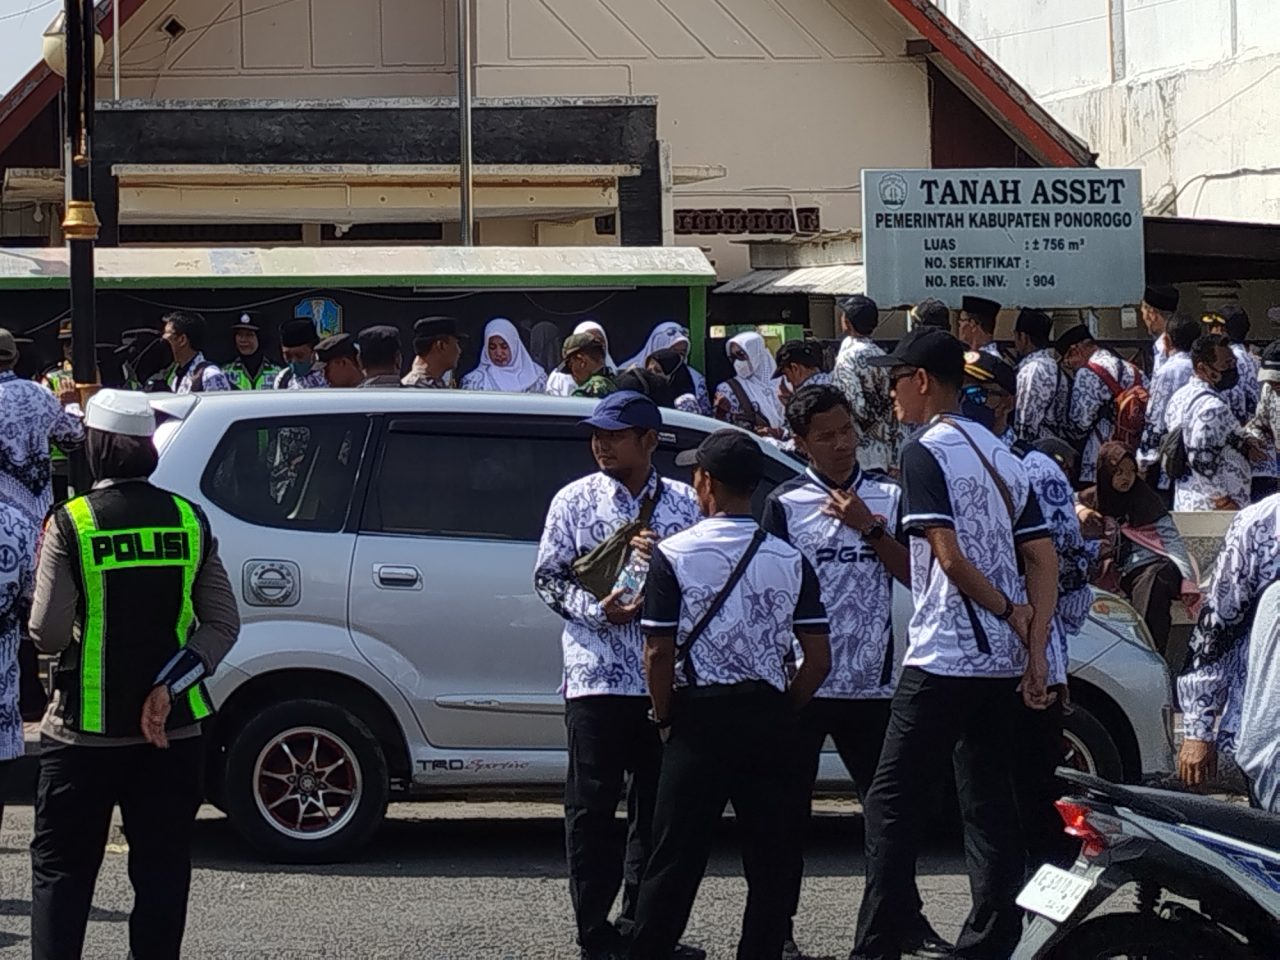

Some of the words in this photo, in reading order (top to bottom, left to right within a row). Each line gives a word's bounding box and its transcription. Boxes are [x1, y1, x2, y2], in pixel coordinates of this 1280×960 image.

[920, 179, 1021, 205] TANAH
[1031, 179, 1125, 205] ASSET
[875, 212, 964, 228] PEMERINTAH
[969, 212, 1050, 228] KABUPATEN
[1055, 212, 1132, 228] PONOROGO
[924, 238, 956, 250] LUAS
[1043, 238, 1065, 250] 756
[925, 257, 946, 269] NO.
[949, 256, 1021, 269] SERTIFIKAT
[925, 275, 947, 287] NO.
[950, 275, 979, 287] REG.
[983, 275, 1007, 287] INV.
[1033, 275, 1055, 287] 904
[91, 531, 190, 566] POLISI
[815, 545, 879, 566] PGR
[416, 759, 464, 771] TRD
